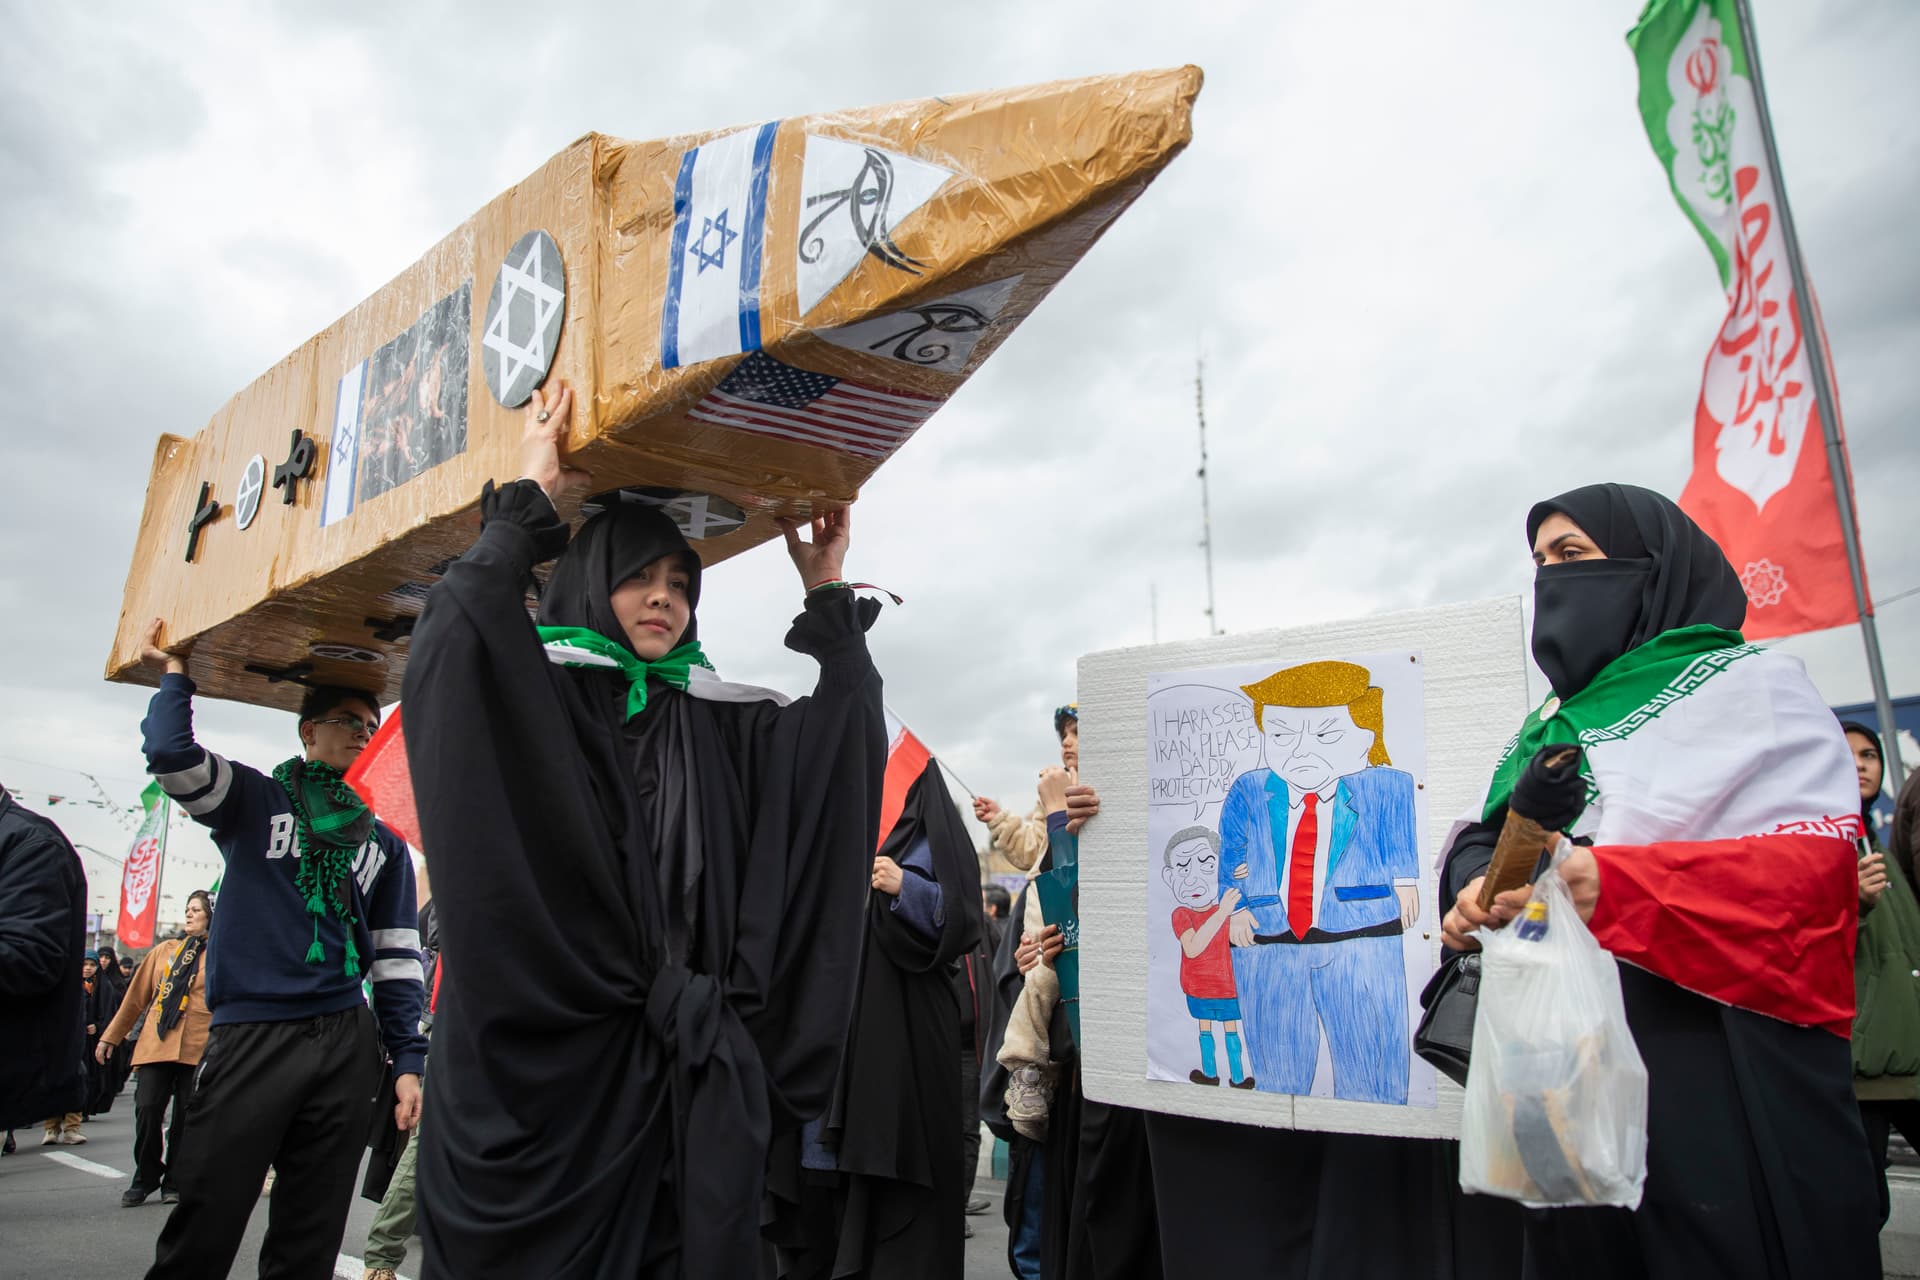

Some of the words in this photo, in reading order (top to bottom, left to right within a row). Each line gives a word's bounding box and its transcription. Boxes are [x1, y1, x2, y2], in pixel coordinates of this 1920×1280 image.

[1153, 709, 1158, 737] I
[1164, 702, 1254, 737] HARASSED
[1153, 736, 1197, 764] IRAN,
[1199, 726, 1258, 758] PLEASE
